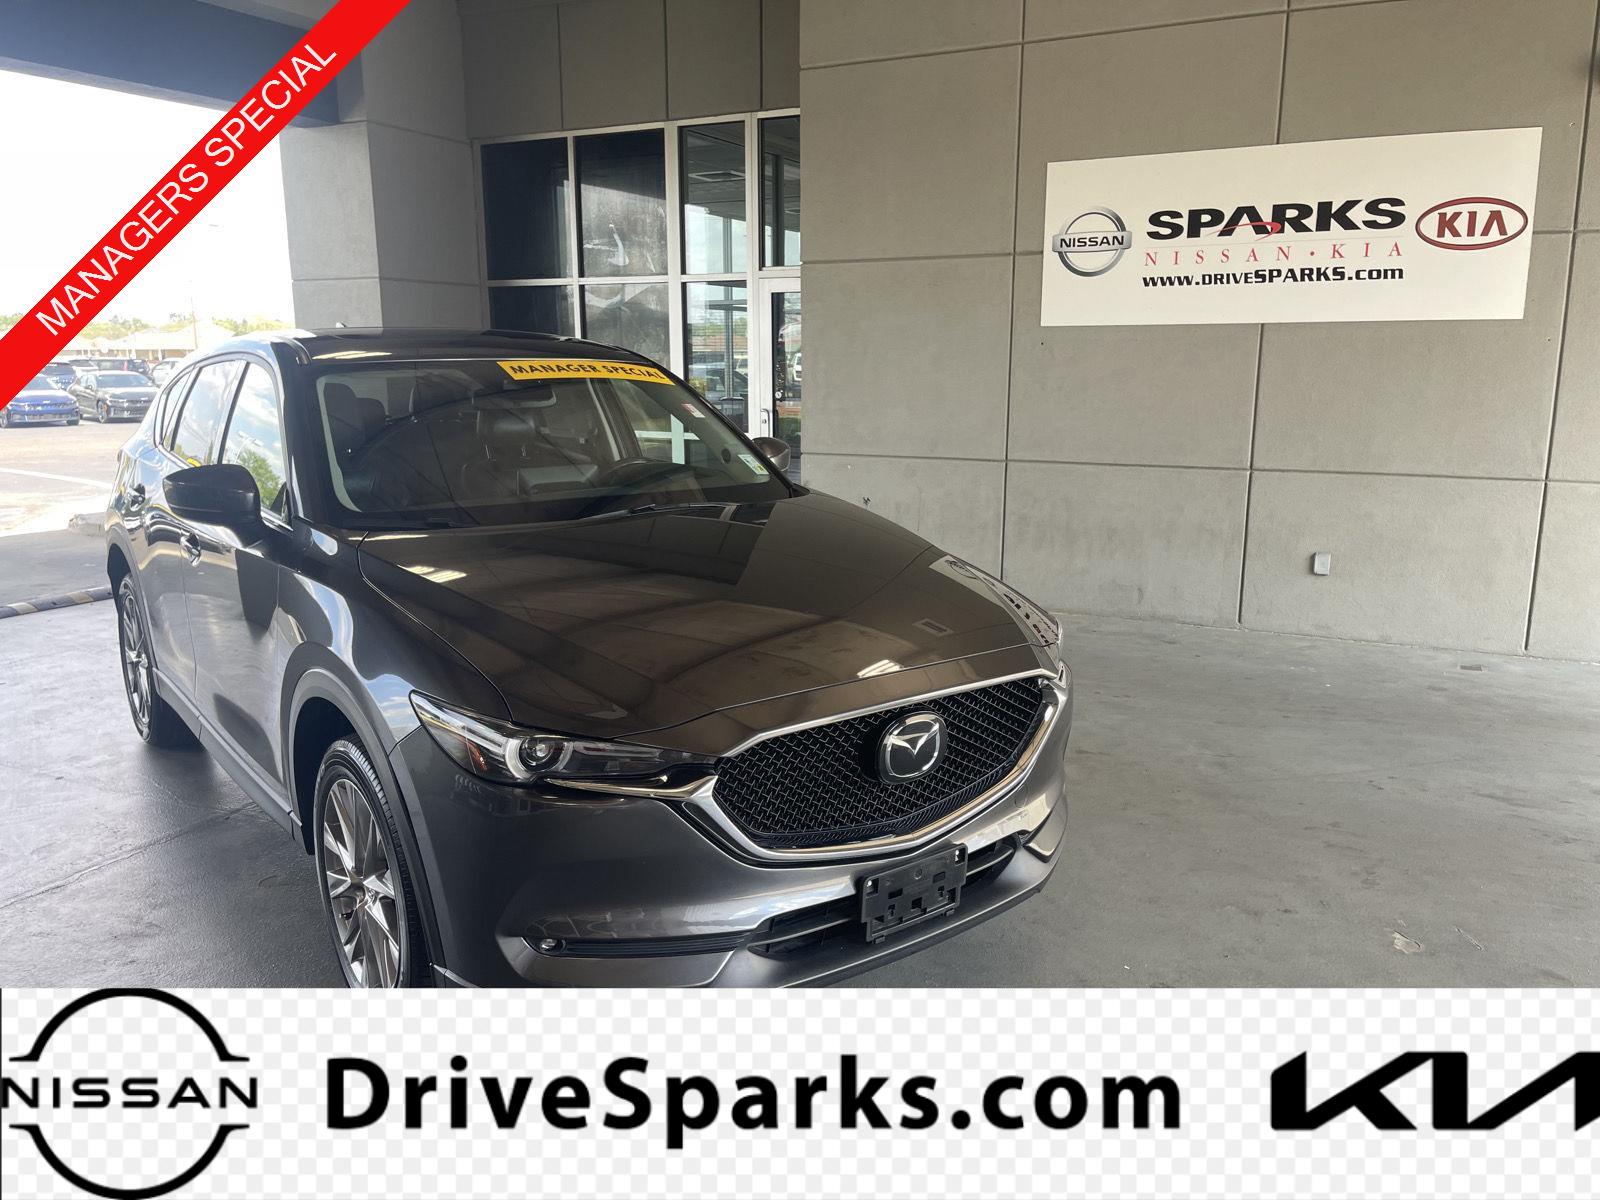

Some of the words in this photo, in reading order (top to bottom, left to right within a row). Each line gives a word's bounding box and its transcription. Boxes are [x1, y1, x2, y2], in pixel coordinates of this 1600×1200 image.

[1146, 197, 1406, 242] SPARKS
[1437, 210, 1508, 238] KIA
[1059, 235, 1125, 249] NISSAN
[1144, 245, 1292, 267] NISSAN
[1330, 241, 1403, 259] KIA
[510, 364, 601, 375] MANAGER
[602, 365, 667, 380] SPECIAL
